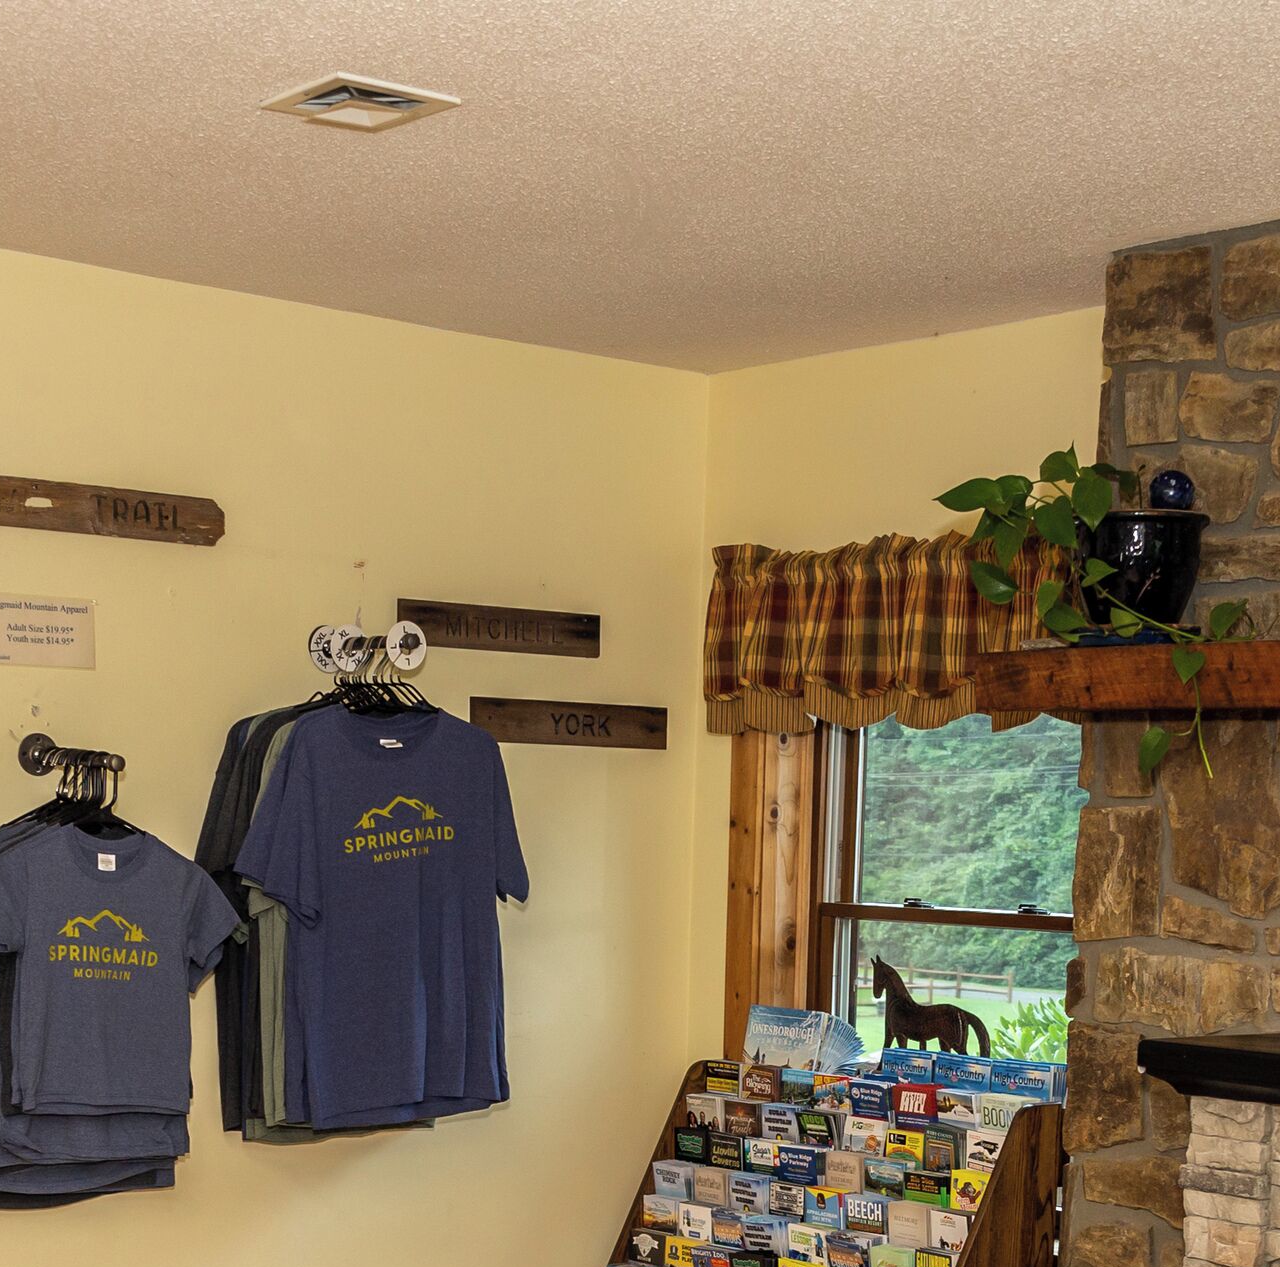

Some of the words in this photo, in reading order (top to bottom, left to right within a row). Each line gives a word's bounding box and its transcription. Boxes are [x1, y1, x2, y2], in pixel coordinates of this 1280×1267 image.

[90, 493, 186, 533] TRAIL
[24, 602, 58, 612] Mountain
[60, 605, 88, 615] Apparel
[6, 623, 26, 632] Adult
[28, 624, 43, 633] Size
[445, 616, 565, 645] MITCHELL
[6, 634, 29, 643] Youth
[550, 713, 612, 737] YORK
[48, 944, 159, 968] SPRINGMAID
[73, 967, 132, 982] MOUNTAIN
[748, 1021, 816, 1044] JONESBOROUGH
[883, 1061, 899, 1073] High
[900, 1062, 928, 1075] Country
[938, 1064, 954, 1079] High
[955, 1066, 986, 1083] Country
[994, 1071, 1011, 1087] High
[1013, 1074, 1046, 1089] Country
[713, 1145, 738, 1158] Linville
[711, 1156, 740, 1168] Caverns
[656, 1168, 680, 1179] CHIMNEY
[662, 1176, 676, 1185] ROCK
[847, 1199, 882, 1221] BEECH
